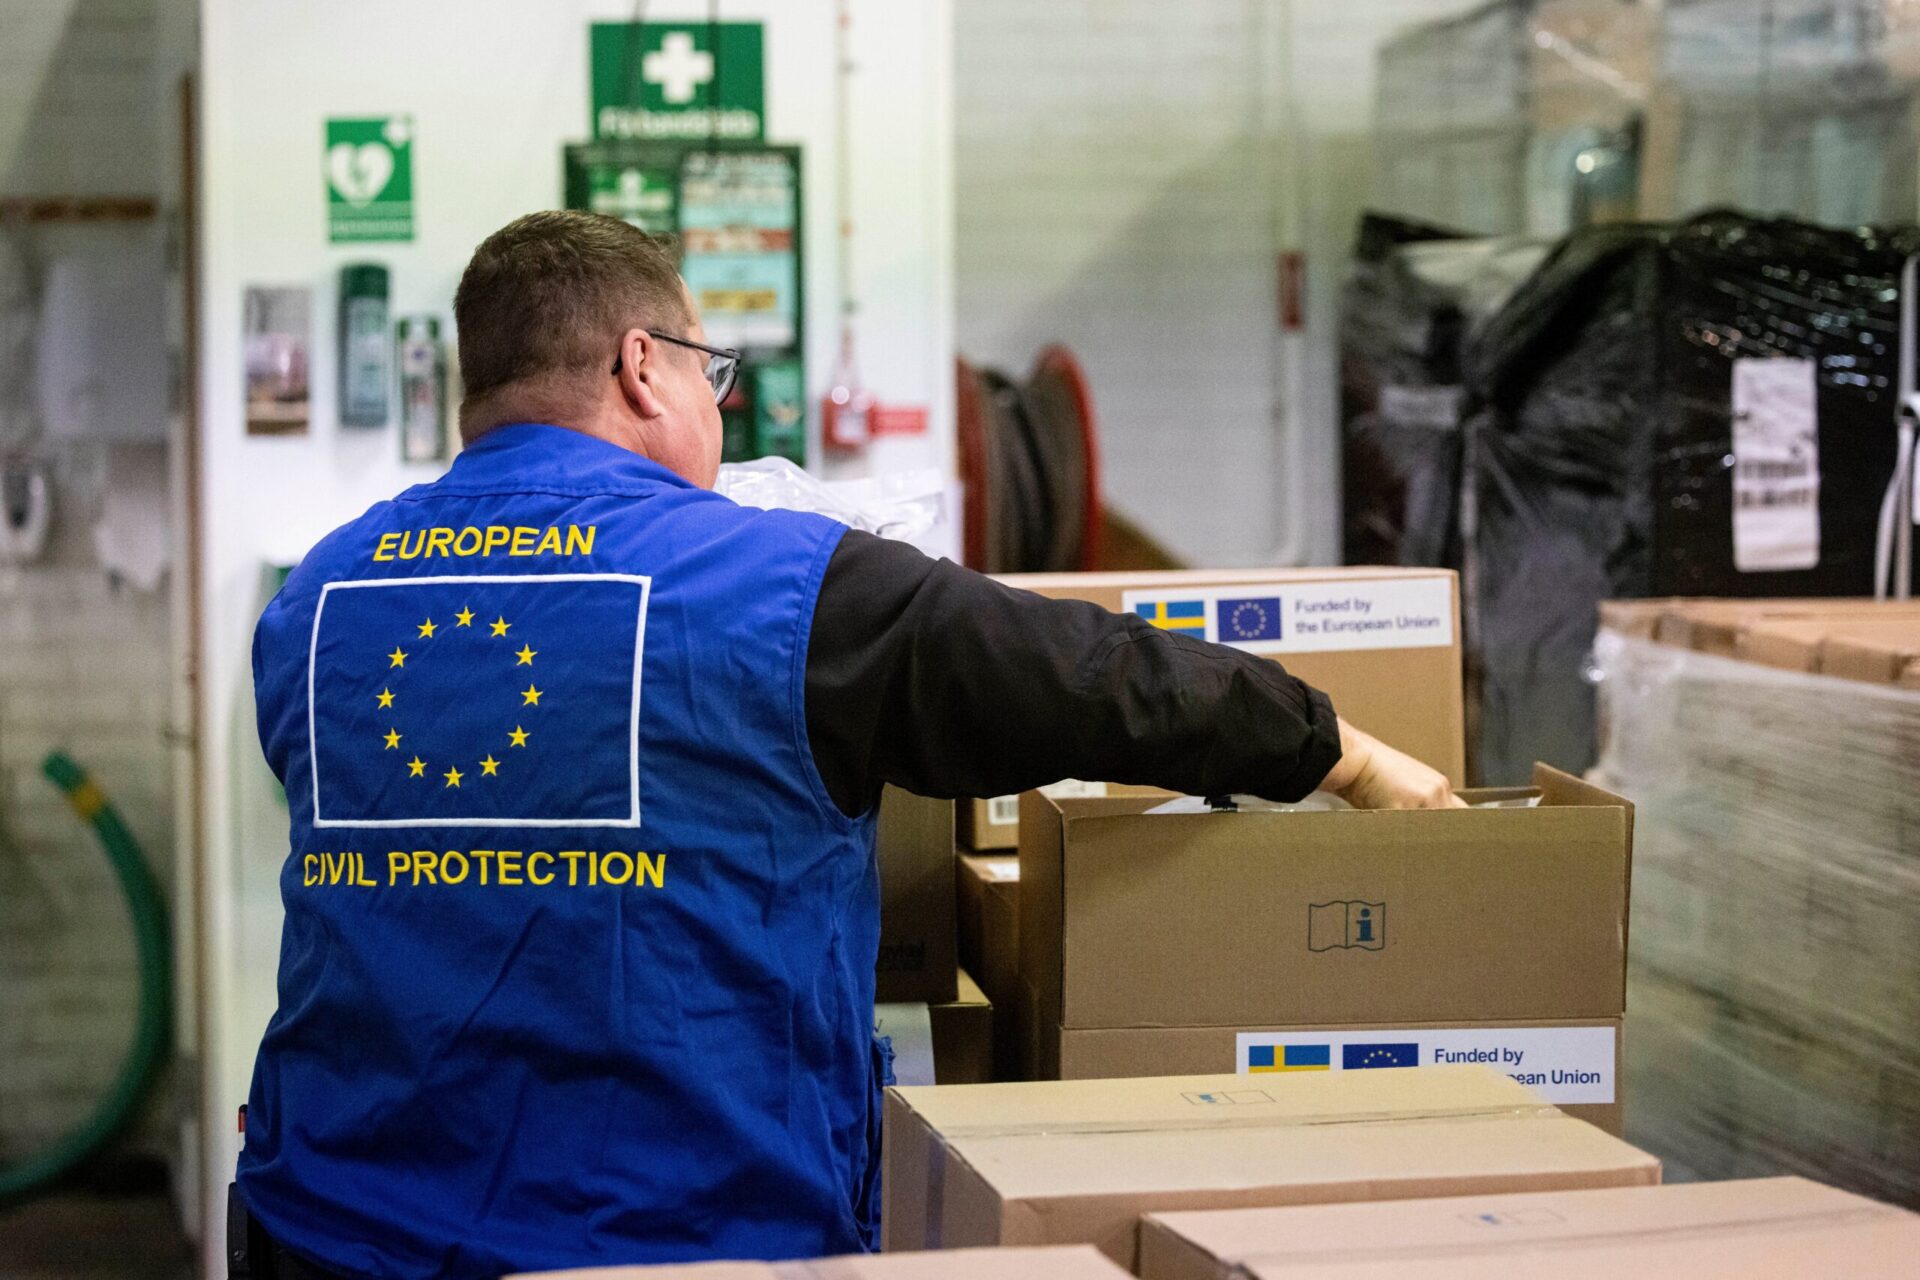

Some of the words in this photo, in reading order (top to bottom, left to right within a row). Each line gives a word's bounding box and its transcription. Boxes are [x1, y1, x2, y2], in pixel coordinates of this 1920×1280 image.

[373, 525, 596, 562] EUROPEAN
[1294, 599, 1350, 613] Funded
[1354, 599, 1373, 613] by
[1294, 620, 1319, 633] the
[1322, 618, 1393, 633] European
[1396, 616, 1440, 629] Union
[303, 852, 377, 888] CIVIL
[387, 850, 666, 889] PROTECTION
[1434, 1047, 1498, 1064] Funded
[1503, 1047, 1524, 1066] by
[1551, 1069, 1601, 1085] Union
